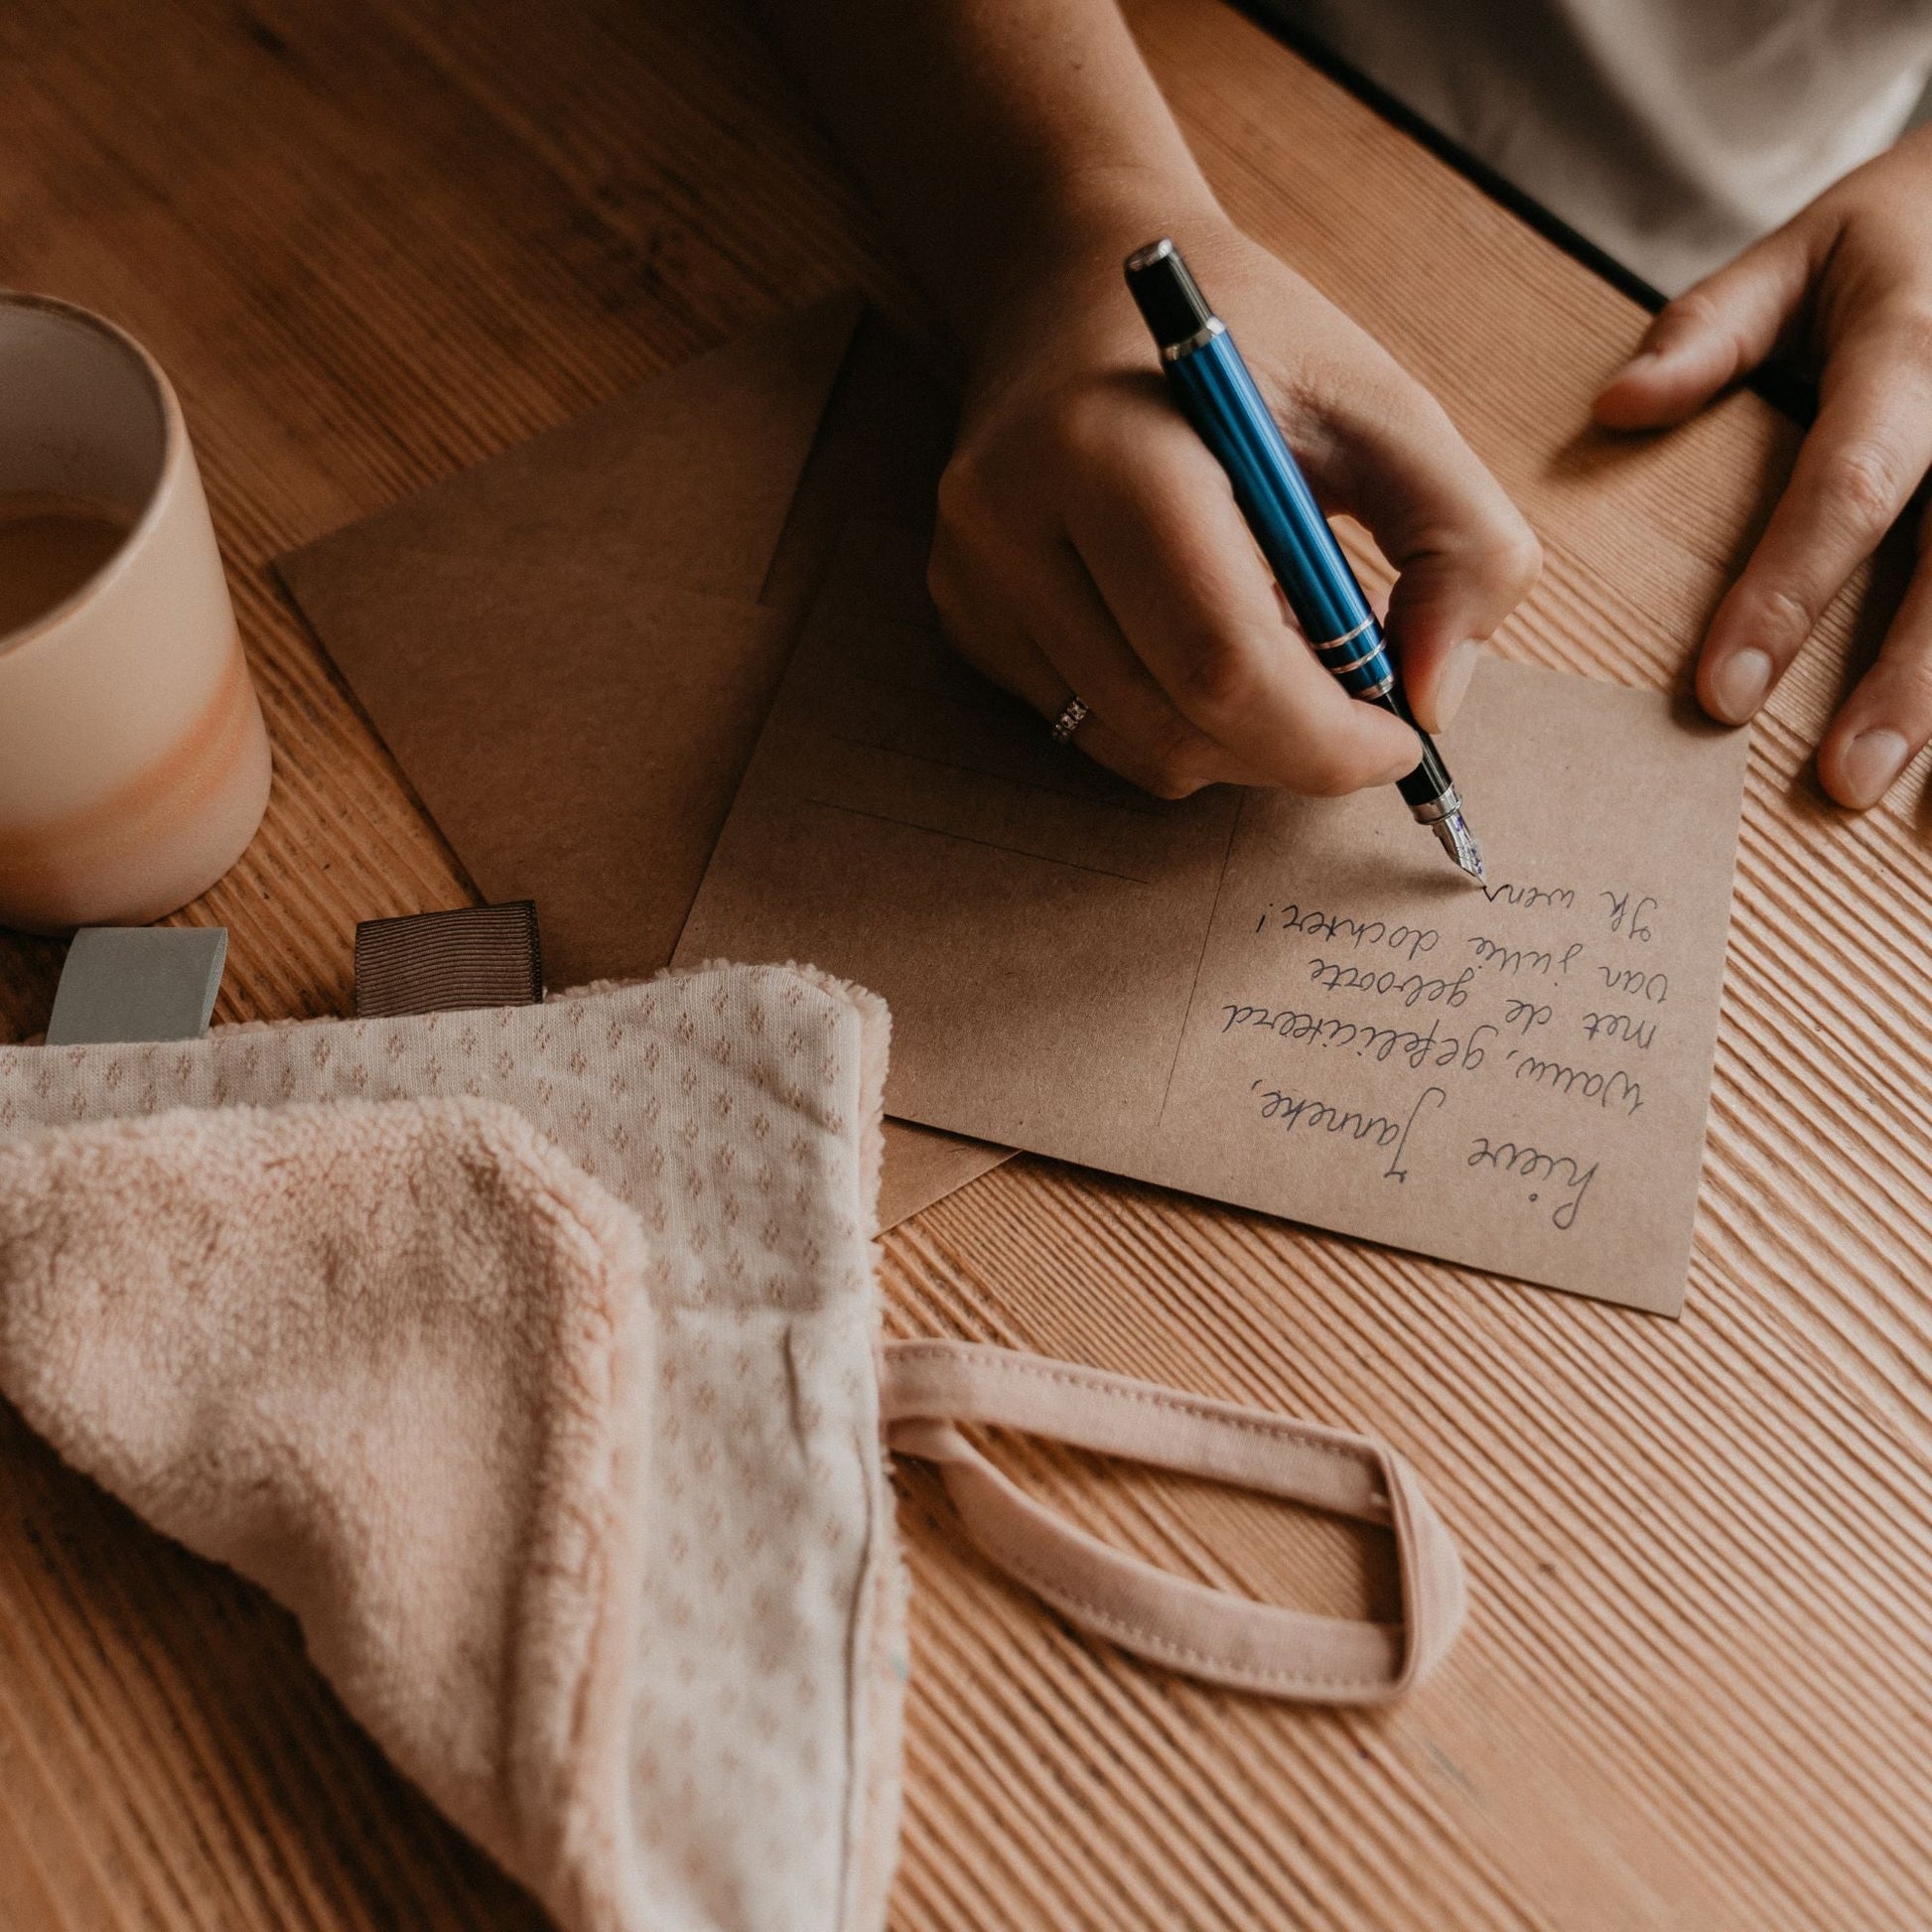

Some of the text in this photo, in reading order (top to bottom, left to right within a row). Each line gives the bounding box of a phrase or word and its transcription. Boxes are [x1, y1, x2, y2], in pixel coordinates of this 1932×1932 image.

[1254, 901, 1439, 960] dochter!
[1599, 891, 1657, 941] Ik
[1309, 959, 1475, 1009] geboorte
[1466, 936, 1584, 988] jullie
[1503, 999, 1551, 1035] de
[1221, 1004, 1645, 1116] Wauw, gefeliciteerd
[1251, 1079, 1446, 1184] Janneke,
